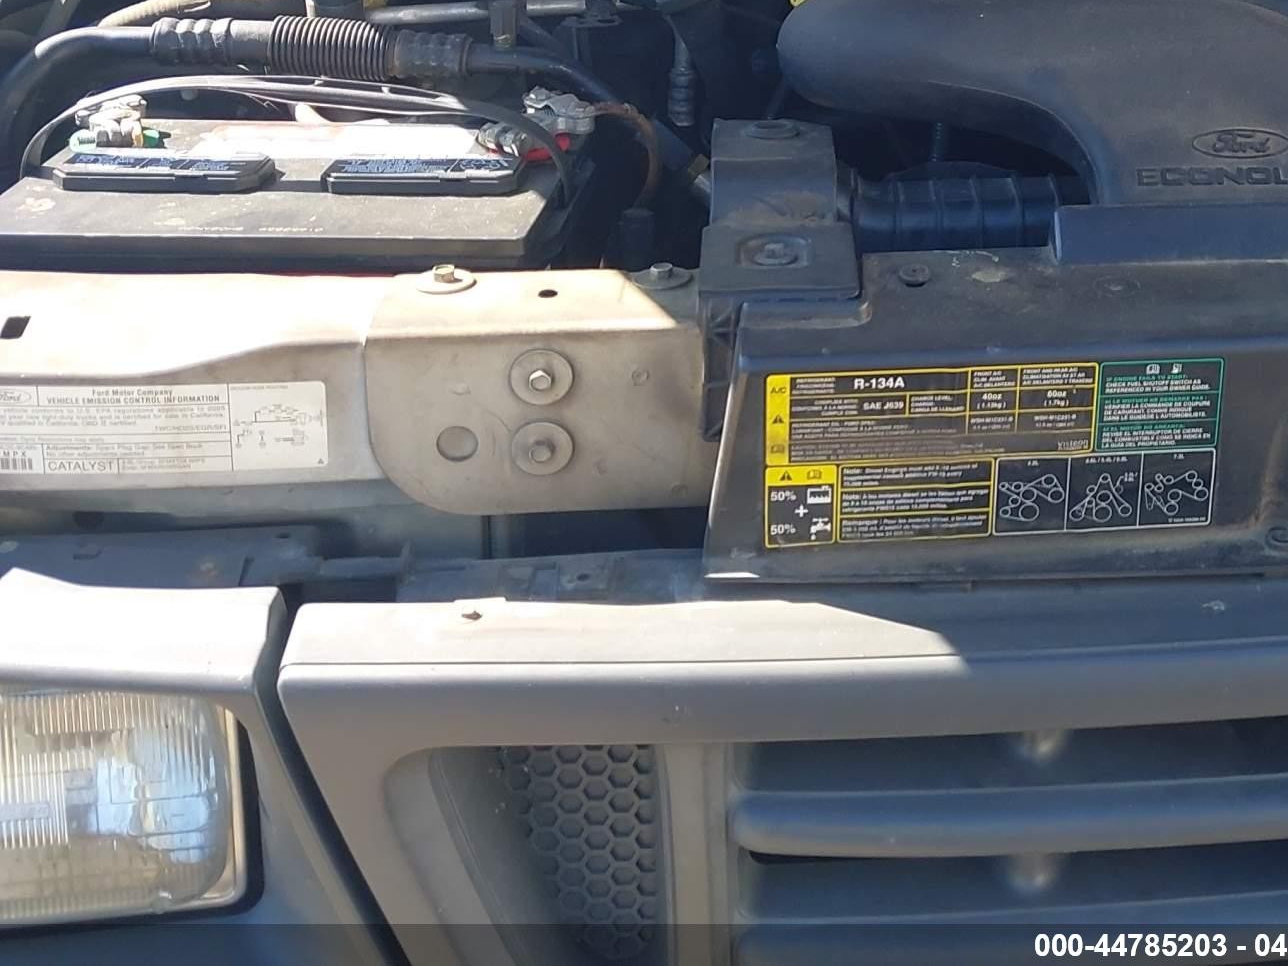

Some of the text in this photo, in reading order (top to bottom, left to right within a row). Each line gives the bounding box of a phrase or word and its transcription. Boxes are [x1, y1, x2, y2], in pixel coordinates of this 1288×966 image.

[1212, 133, 1270, 154] Ford
[853, 377, 905, 389] R-134A
[164, 395, 220, 403] INFORMATION
[1047, 390, 1067, 398] 60oz
[863, 402, 882, 410] SAE
[48, 460, 113, 472] CATALYST
[770, 490, 796, 501] 50%
[770, 524, 796, 535] 50%
